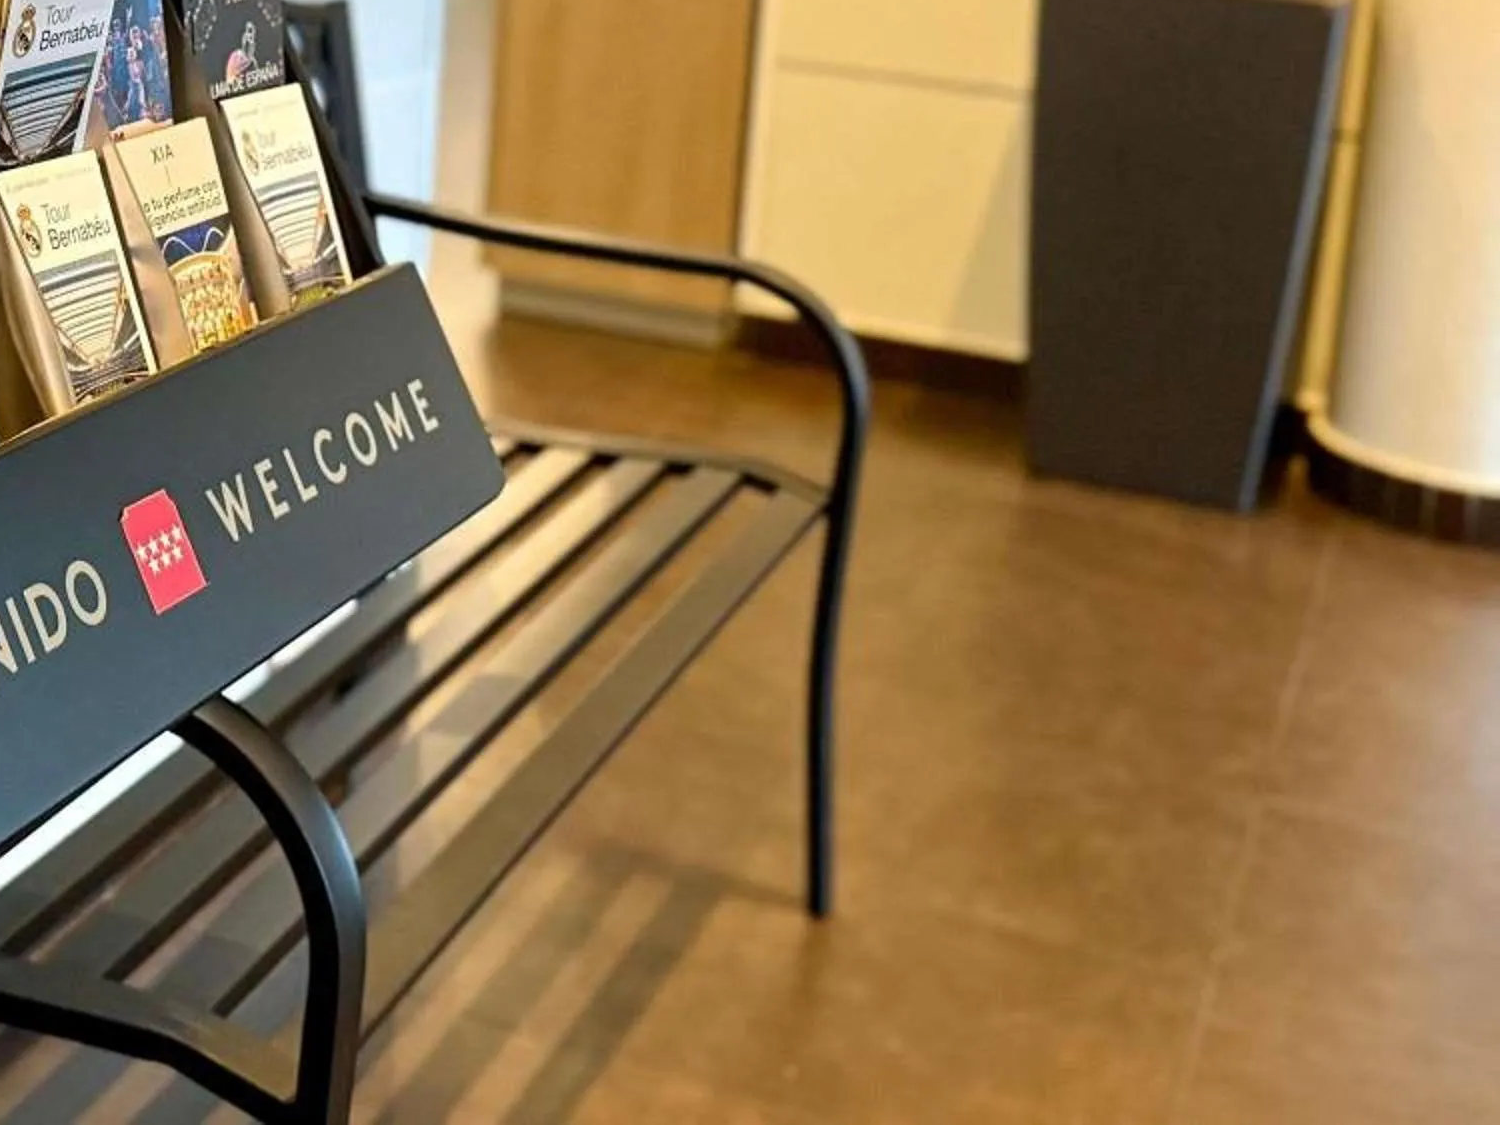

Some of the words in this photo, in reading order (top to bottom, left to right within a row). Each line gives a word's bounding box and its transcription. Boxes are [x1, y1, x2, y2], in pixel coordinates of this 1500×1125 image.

[46, 4, 75, 26] Tour
[39, 17, 106, 53] Bernabéu
[150, 143, 174, 164] XIA
[151, 196, 163, 210] tu
[164, 186, 202, 210] perfume
[202, 179, 219, 193] con
[40, 203, 71, 224] Tour
[48, 216, 112, 250] Bernabéu
[204, 378, 441, 543] WELCOME
